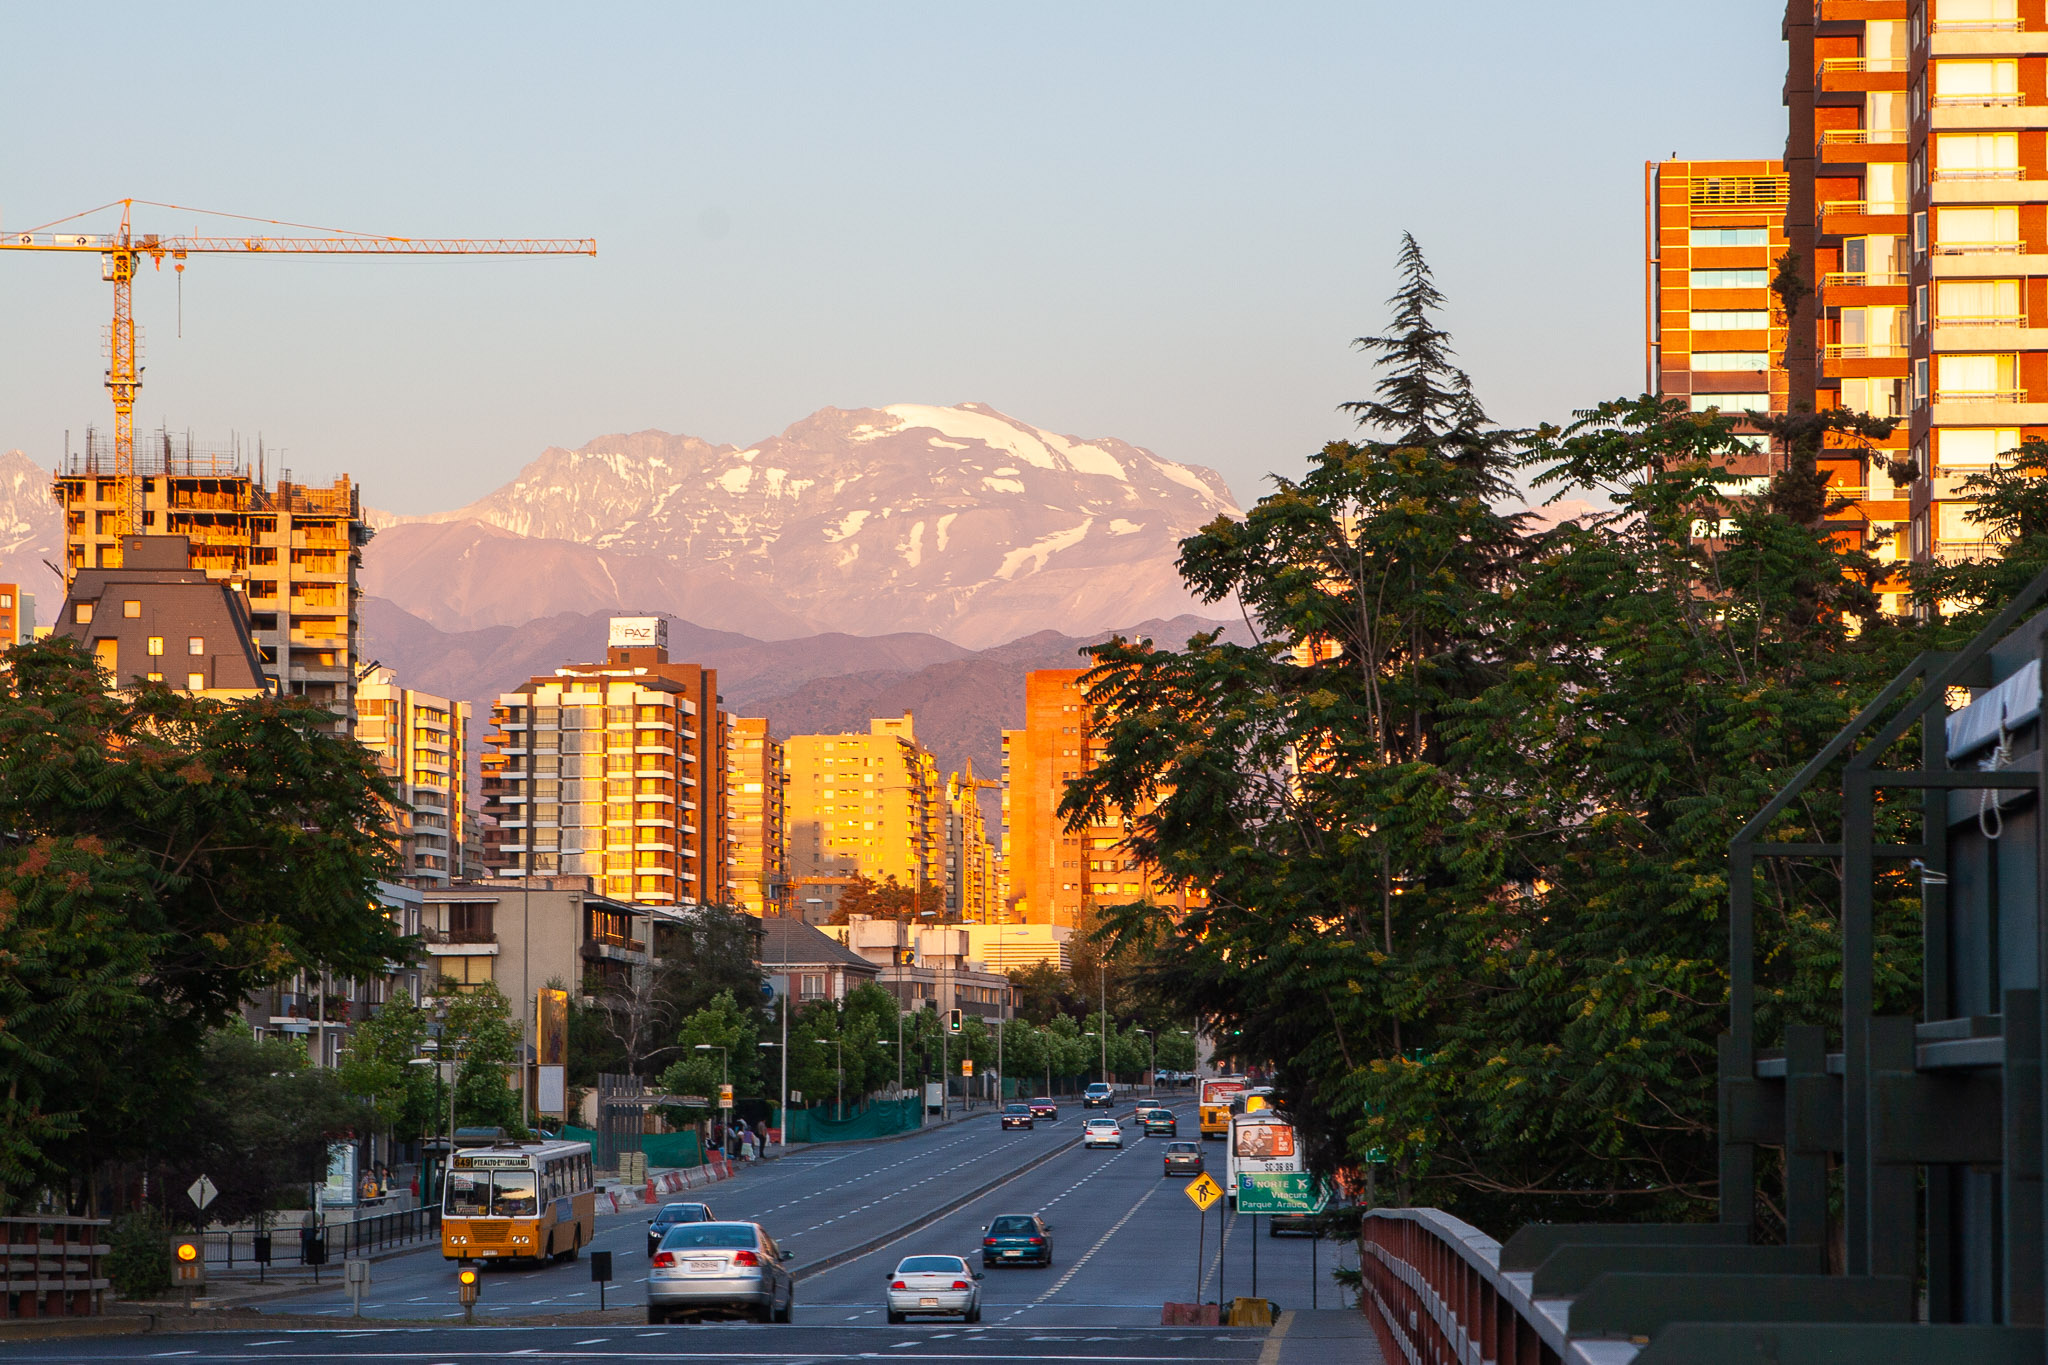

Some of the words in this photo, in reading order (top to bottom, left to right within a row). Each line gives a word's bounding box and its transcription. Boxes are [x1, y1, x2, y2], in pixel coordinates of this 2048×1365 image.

[624, 628, 650, 638] PAZ
[455, 1158, 471, 1168] 649
[1245, 1179, 1252, 1187] 5
[1271, 1191, 1308, 1199] Vitacura
[1242, 1201, 1272, 1210] Parque
[1277, 1201, 1308, 1209] Arauco
